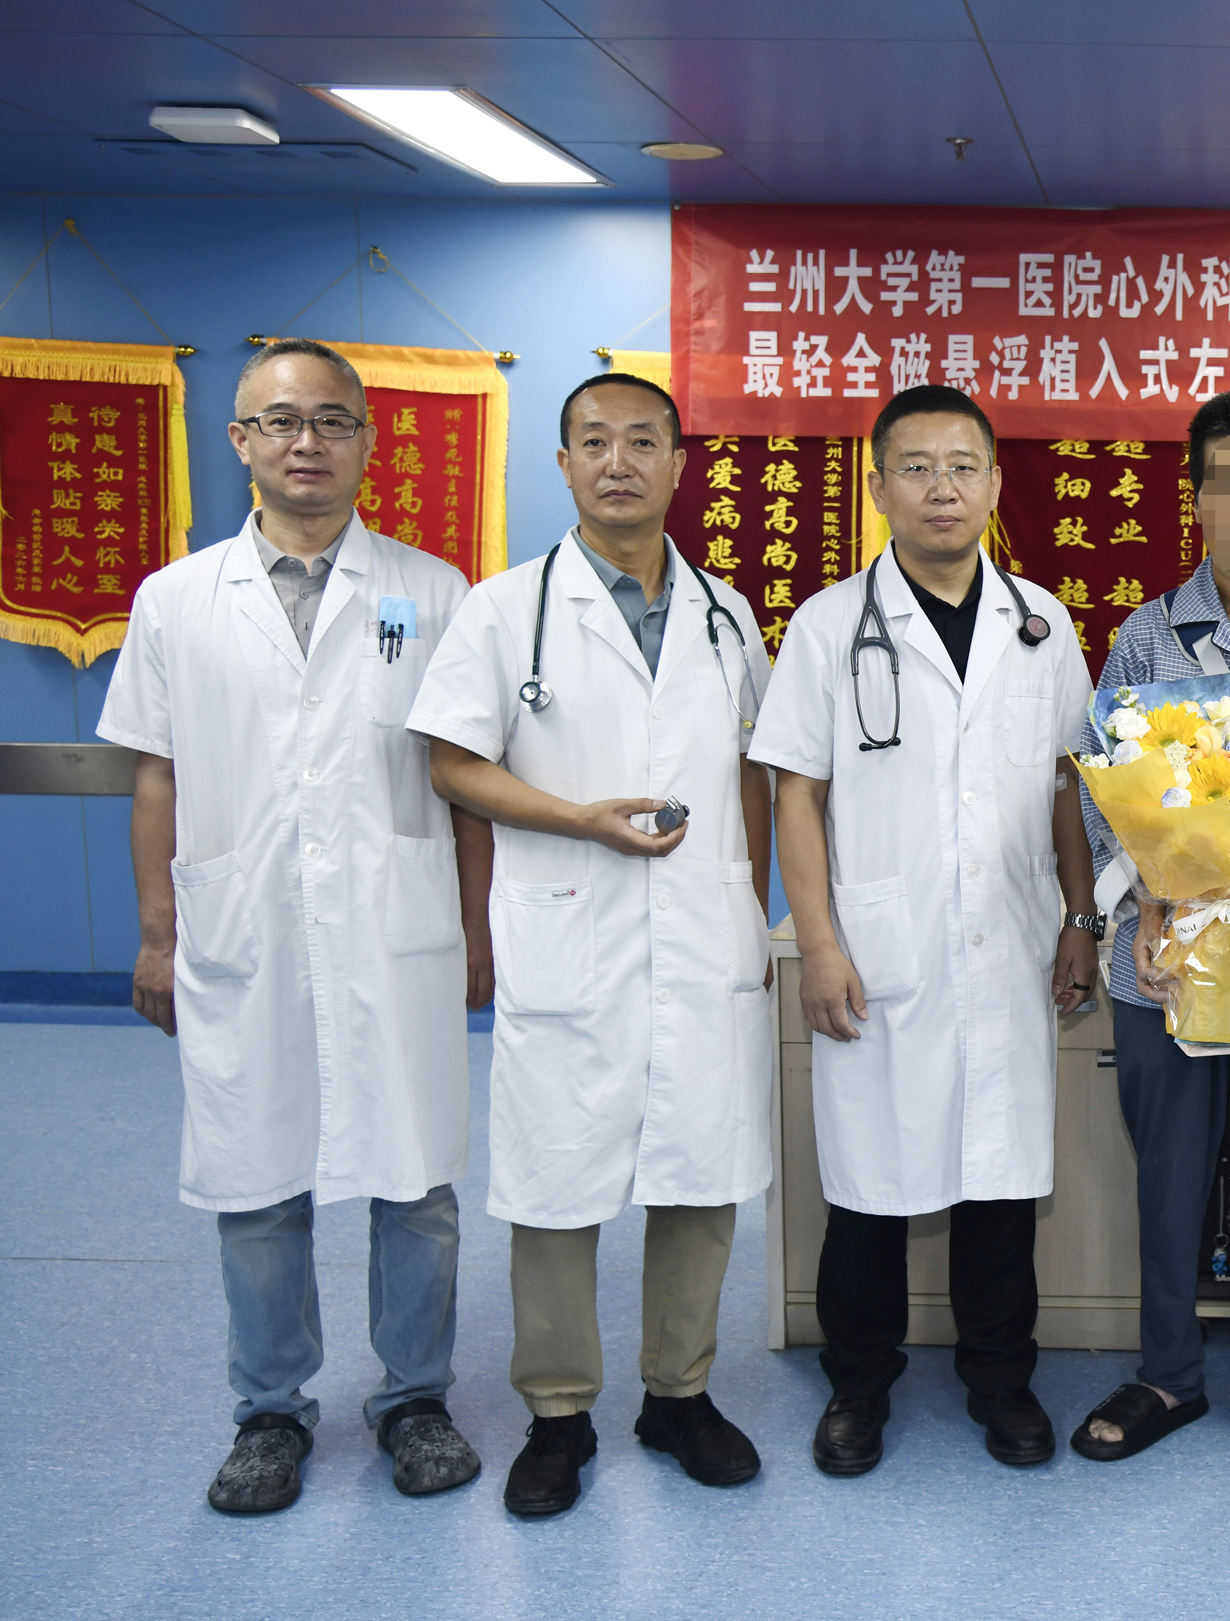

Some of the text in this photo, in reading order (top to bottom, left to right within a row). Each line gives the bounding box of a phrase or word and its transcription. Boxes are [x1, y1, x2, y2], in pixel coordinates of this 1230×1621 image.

[47, 402, 85, 594] 真情体贴暖人心
[88, 405, 126, 595] 待患如亲关怀至
[389, 406, 426, 549] 医德高尚
[759, 435, 803, 670] 医德高尚医术
[1102, 439, 1152, 650] 超专业超
